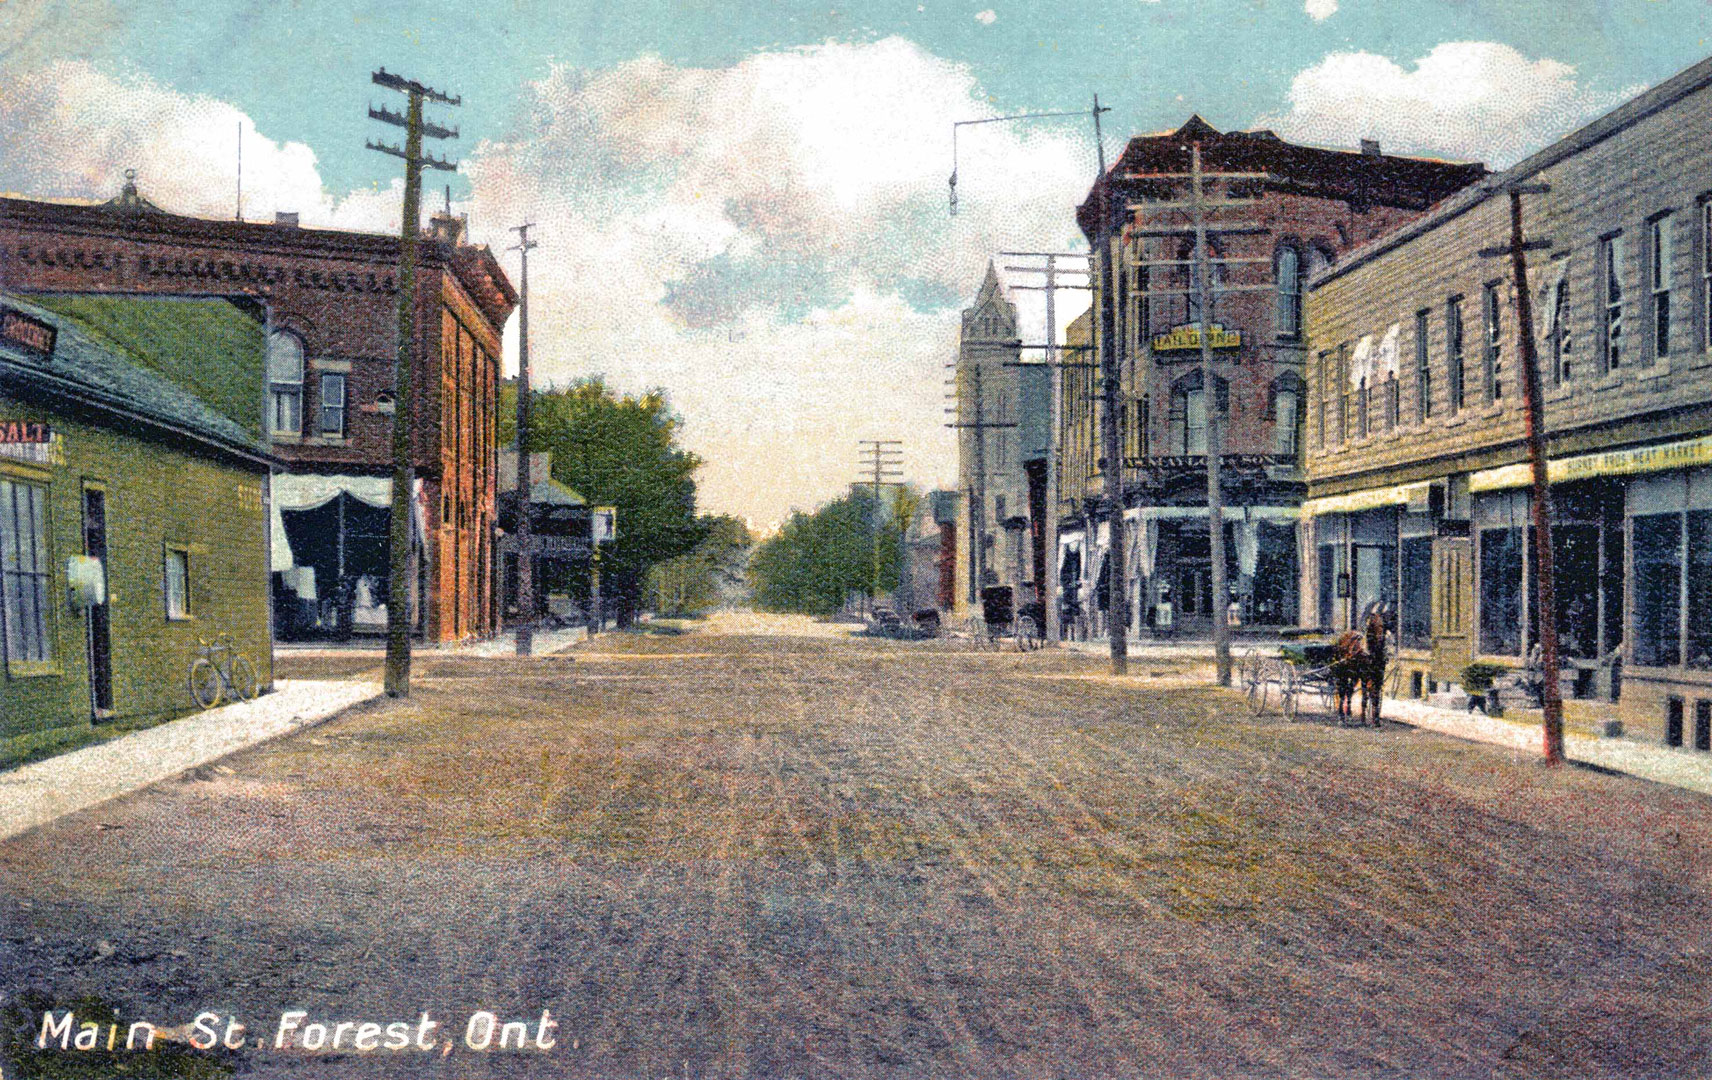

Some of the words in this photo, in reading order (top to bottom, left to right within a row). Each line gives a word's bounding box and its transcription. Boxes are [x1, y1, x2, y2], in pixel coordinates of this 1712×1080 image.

[1156, 331, 1238, 347] TAILOING
[1242, 455, 1275, 465] SON
[1632, 449, 1656, 464] MEAT
